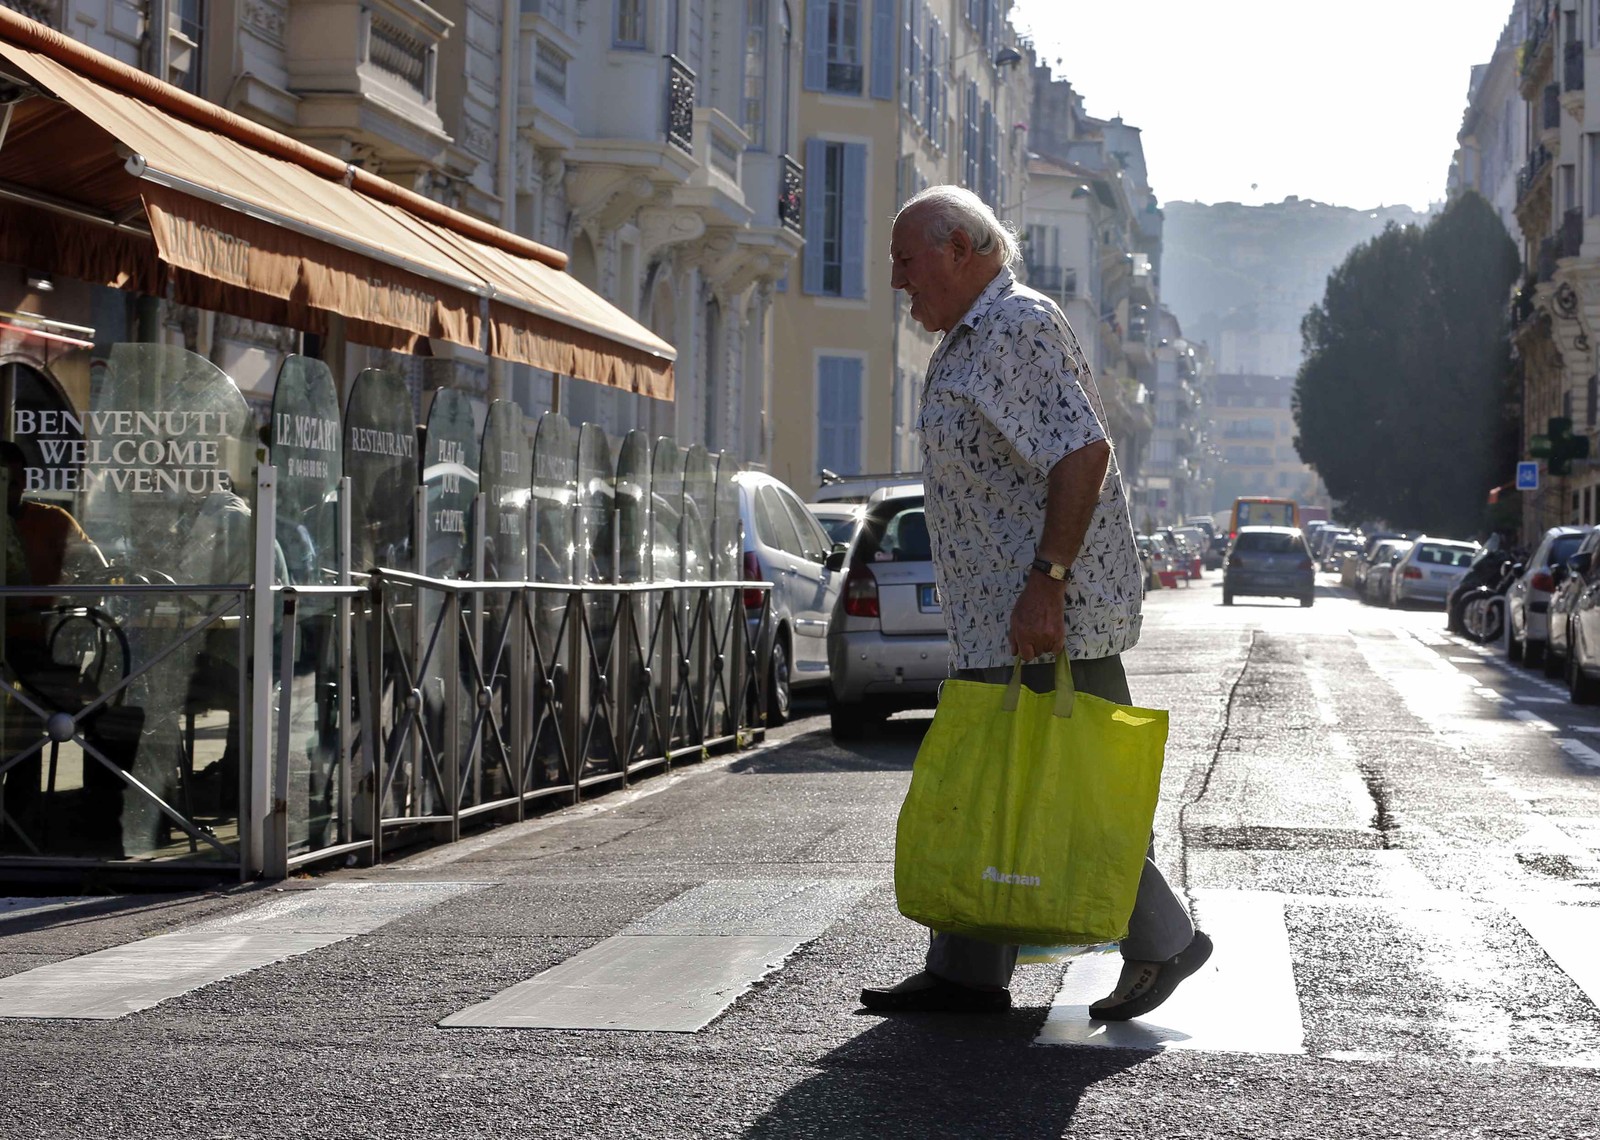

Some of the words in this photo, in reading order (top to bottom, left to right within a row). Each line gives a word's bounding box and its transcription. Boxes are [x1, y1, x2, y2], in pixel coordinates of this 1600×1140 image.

[167, 212, 250, 284] BRASSERIE
[15, 410, 230, 436] BENVENUTI
[276, 412, 291, 446] LE
[295, 414, 338, 452] MOZART
[37, 439, 219, 465] WELCOME
[351, 426, 414, 458] RESTAURANT
[438, 438, 456, 463] PLAT
[23, 467, 233, 494] BIENVENUE
[982, 866, 1041, 887] Auchan
[1123, 969, 1152, 1001] crocs
